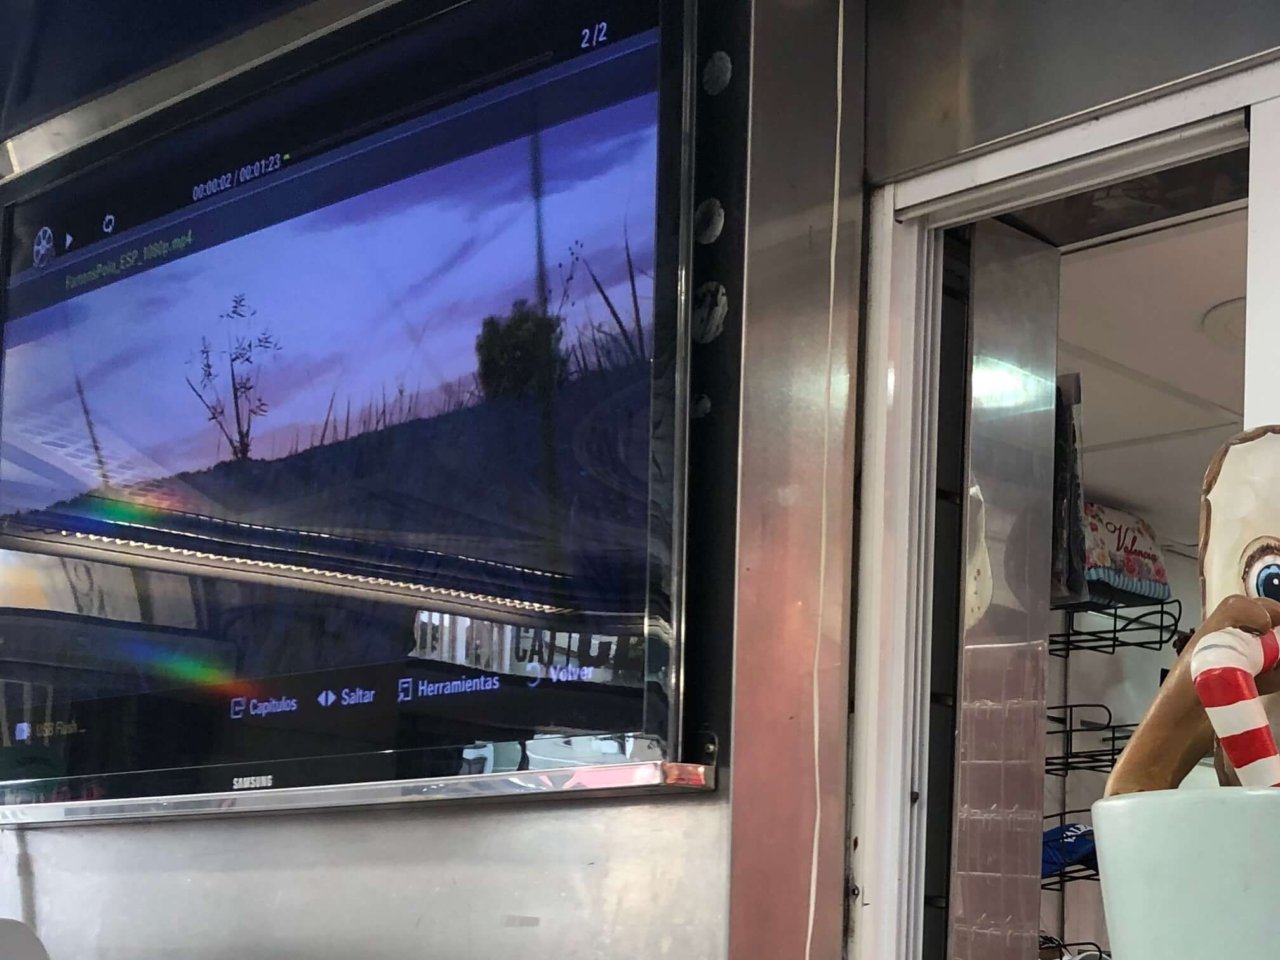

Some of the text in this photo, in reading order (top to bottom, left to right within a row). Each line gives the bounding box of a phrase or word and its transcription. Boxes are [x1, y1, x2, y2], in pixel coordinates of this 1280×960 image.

[581, 22, 607, 48] 2/2
[193, 173, 231, 201] 00:00:02
[239, 153, 281, 183] 00:01:23
[341, 688, 376, 705] Saltar
[418, 674, 499, 697] Herramientas
[551, 663, 594, 684] Volver
[233, 775, 273, 789] SAMSUNG
